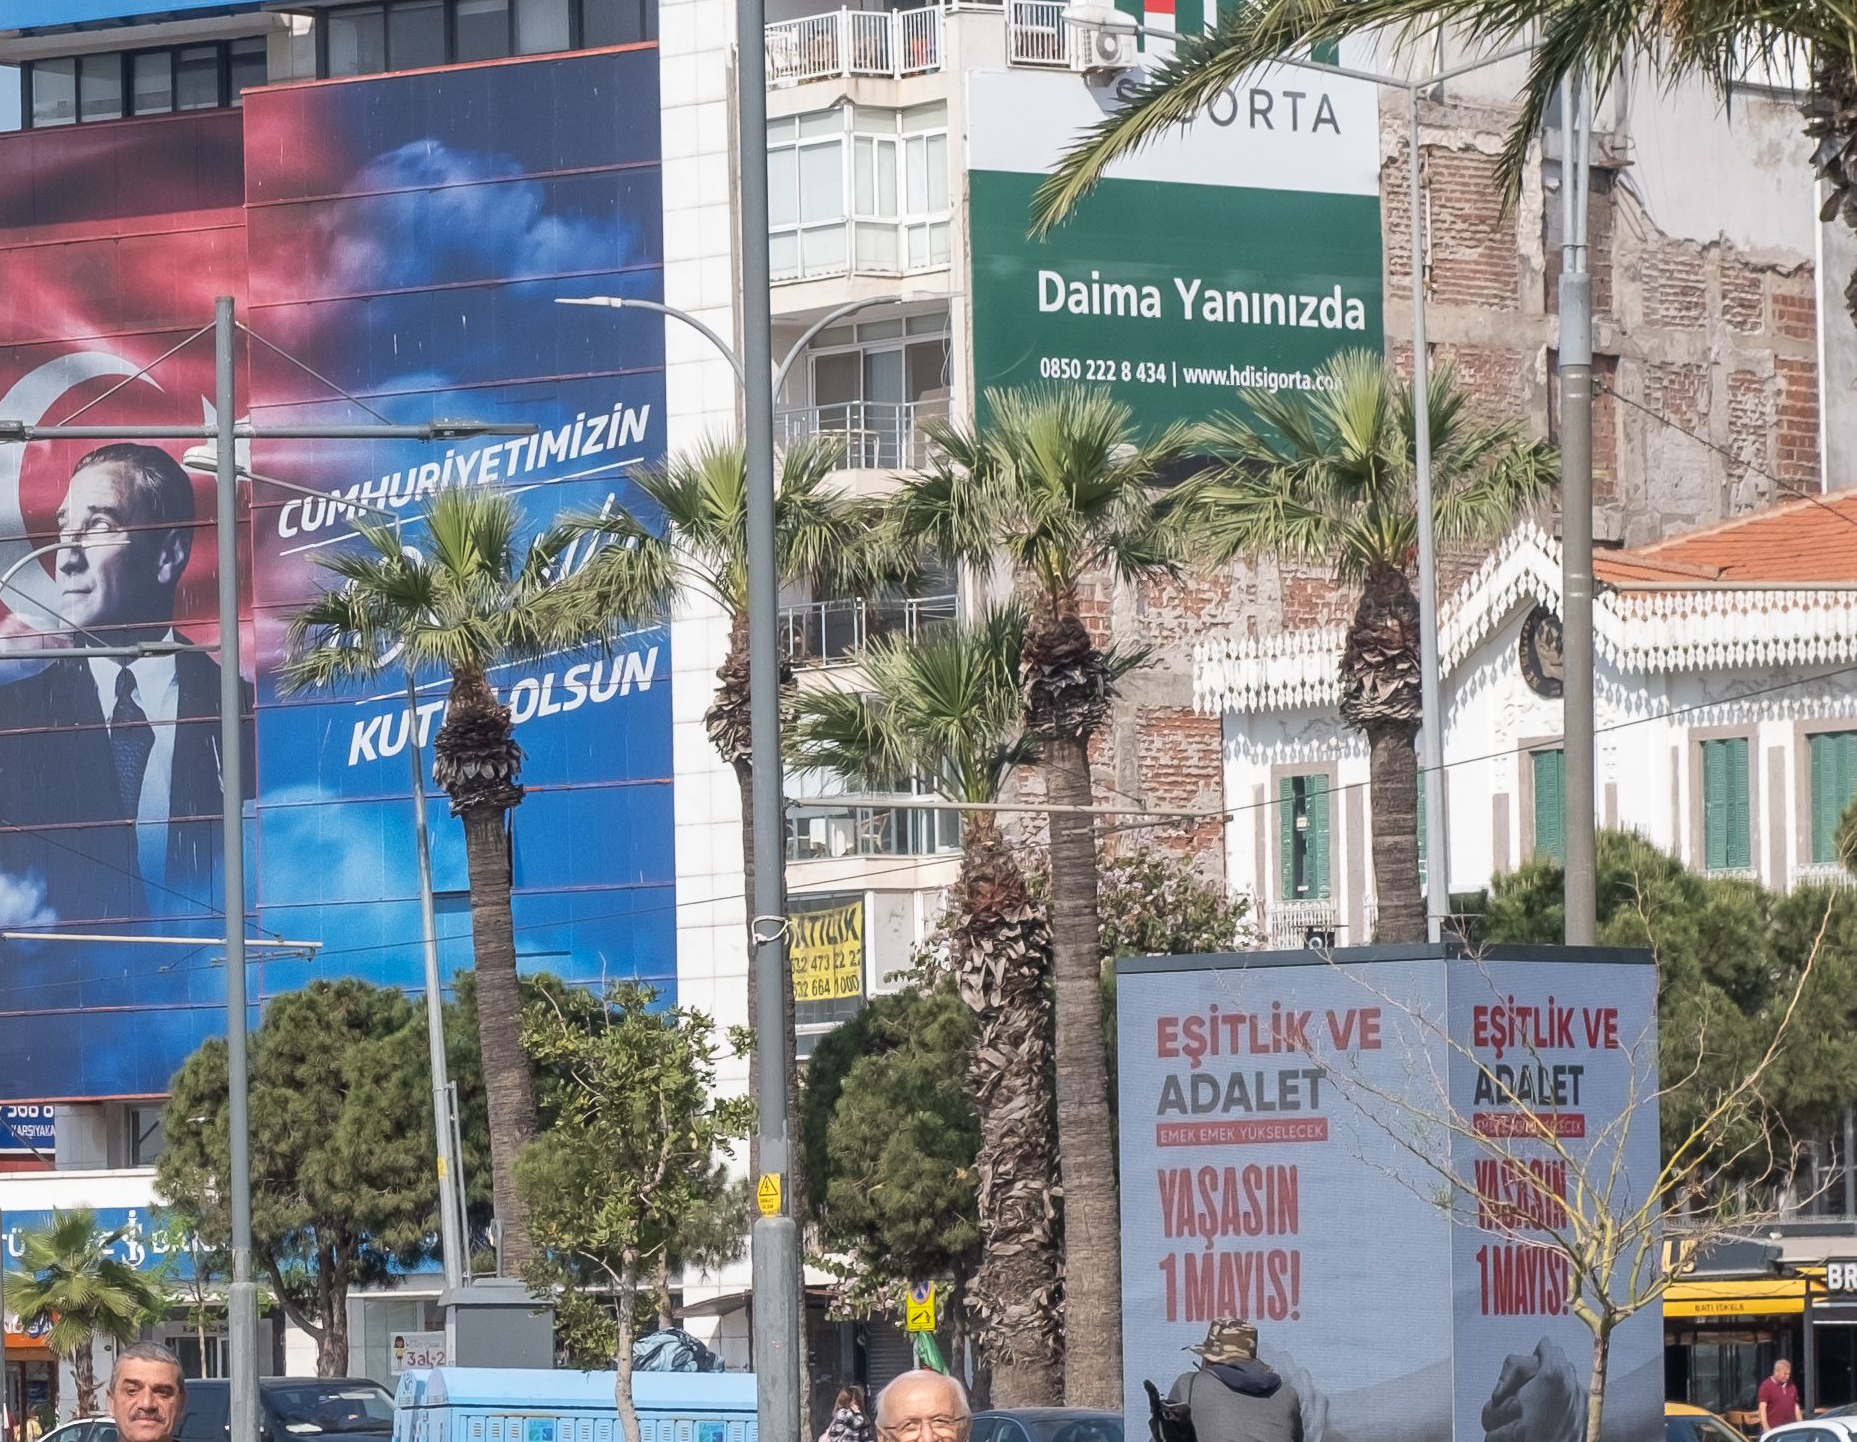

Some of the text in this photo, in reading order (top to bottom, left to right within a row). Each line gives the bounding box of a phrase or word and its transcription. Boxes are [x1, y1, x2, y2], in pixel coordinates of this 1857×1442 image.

[1038, 270, 1367, 331] Daima Yanınızda
[1040, 357, 1081, 380] 0850
[1086, 359, 1117, 381] 222
[1121, 360, 1132, 382] 8
[1136, 362, 1167, 383] 434
[509, 646, 659, 725] OLSUN
[811, 954, 830, 972] 473
[834, 950, 846, 969] 22
[812, 978, 831, 996] 664
[1156, 1001, 1382, 1070] EŞİTLİK VE
[1474, 995, 1620, 1060] EŞİTLİK VE
[1156, 1067, 1327, 1116] ADALET
[1473, 1063, 1585, 1106] ADALET
[1160, 1122, 1324, 1144] EMEK EMEK YÜKSELECEK
[1157, 1163, 1299, 1251] YAŞASIN
[1159, 1250, 1301, 1322] 1 MAYIS!
[1476, 1245, 1570, 1317] 1 MAYIS!
